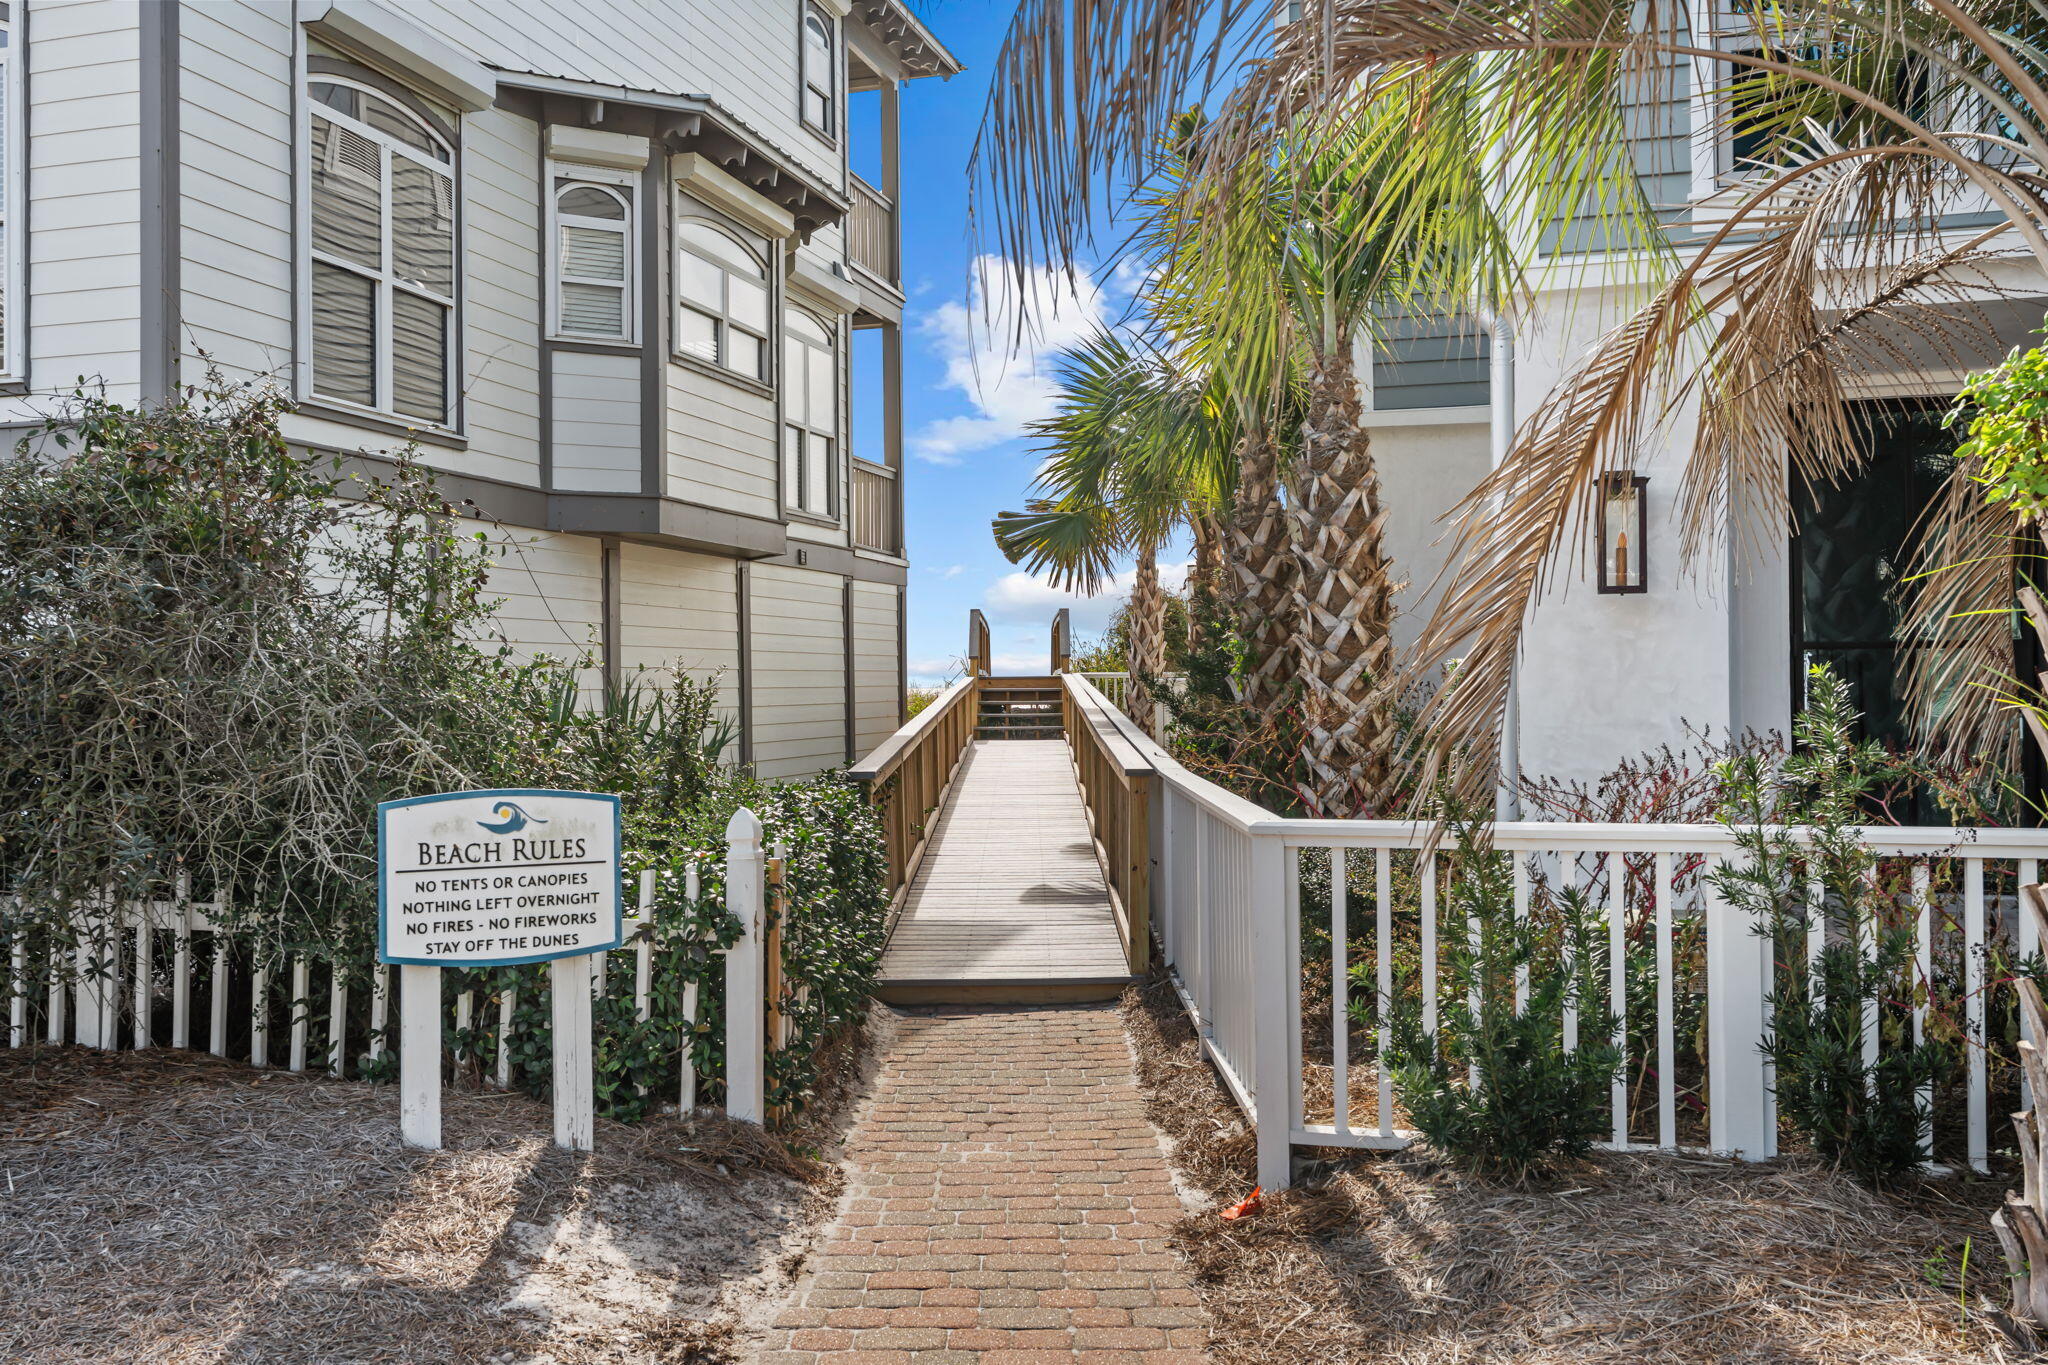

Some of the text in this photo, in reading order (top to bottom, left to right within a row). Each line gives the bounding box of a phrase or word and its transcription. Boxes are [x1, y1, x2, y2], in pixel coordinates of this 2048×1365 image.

[418, 839, 585, 865] BEACH RULES
[416, 873, 587, 892] NO TENTS OR CANOPIES
[403, 892, 599, 914] NOTHING LEFT OVERNIGHT
[407, 923, 427, 935] NO
[434, 920, 473, 933] FIRES
[490, 918, 509, 930] NO
[515, 912, 596, 928] FIREWORKS
[426, 934, 578, 954] STAY OFF THE DUNES
